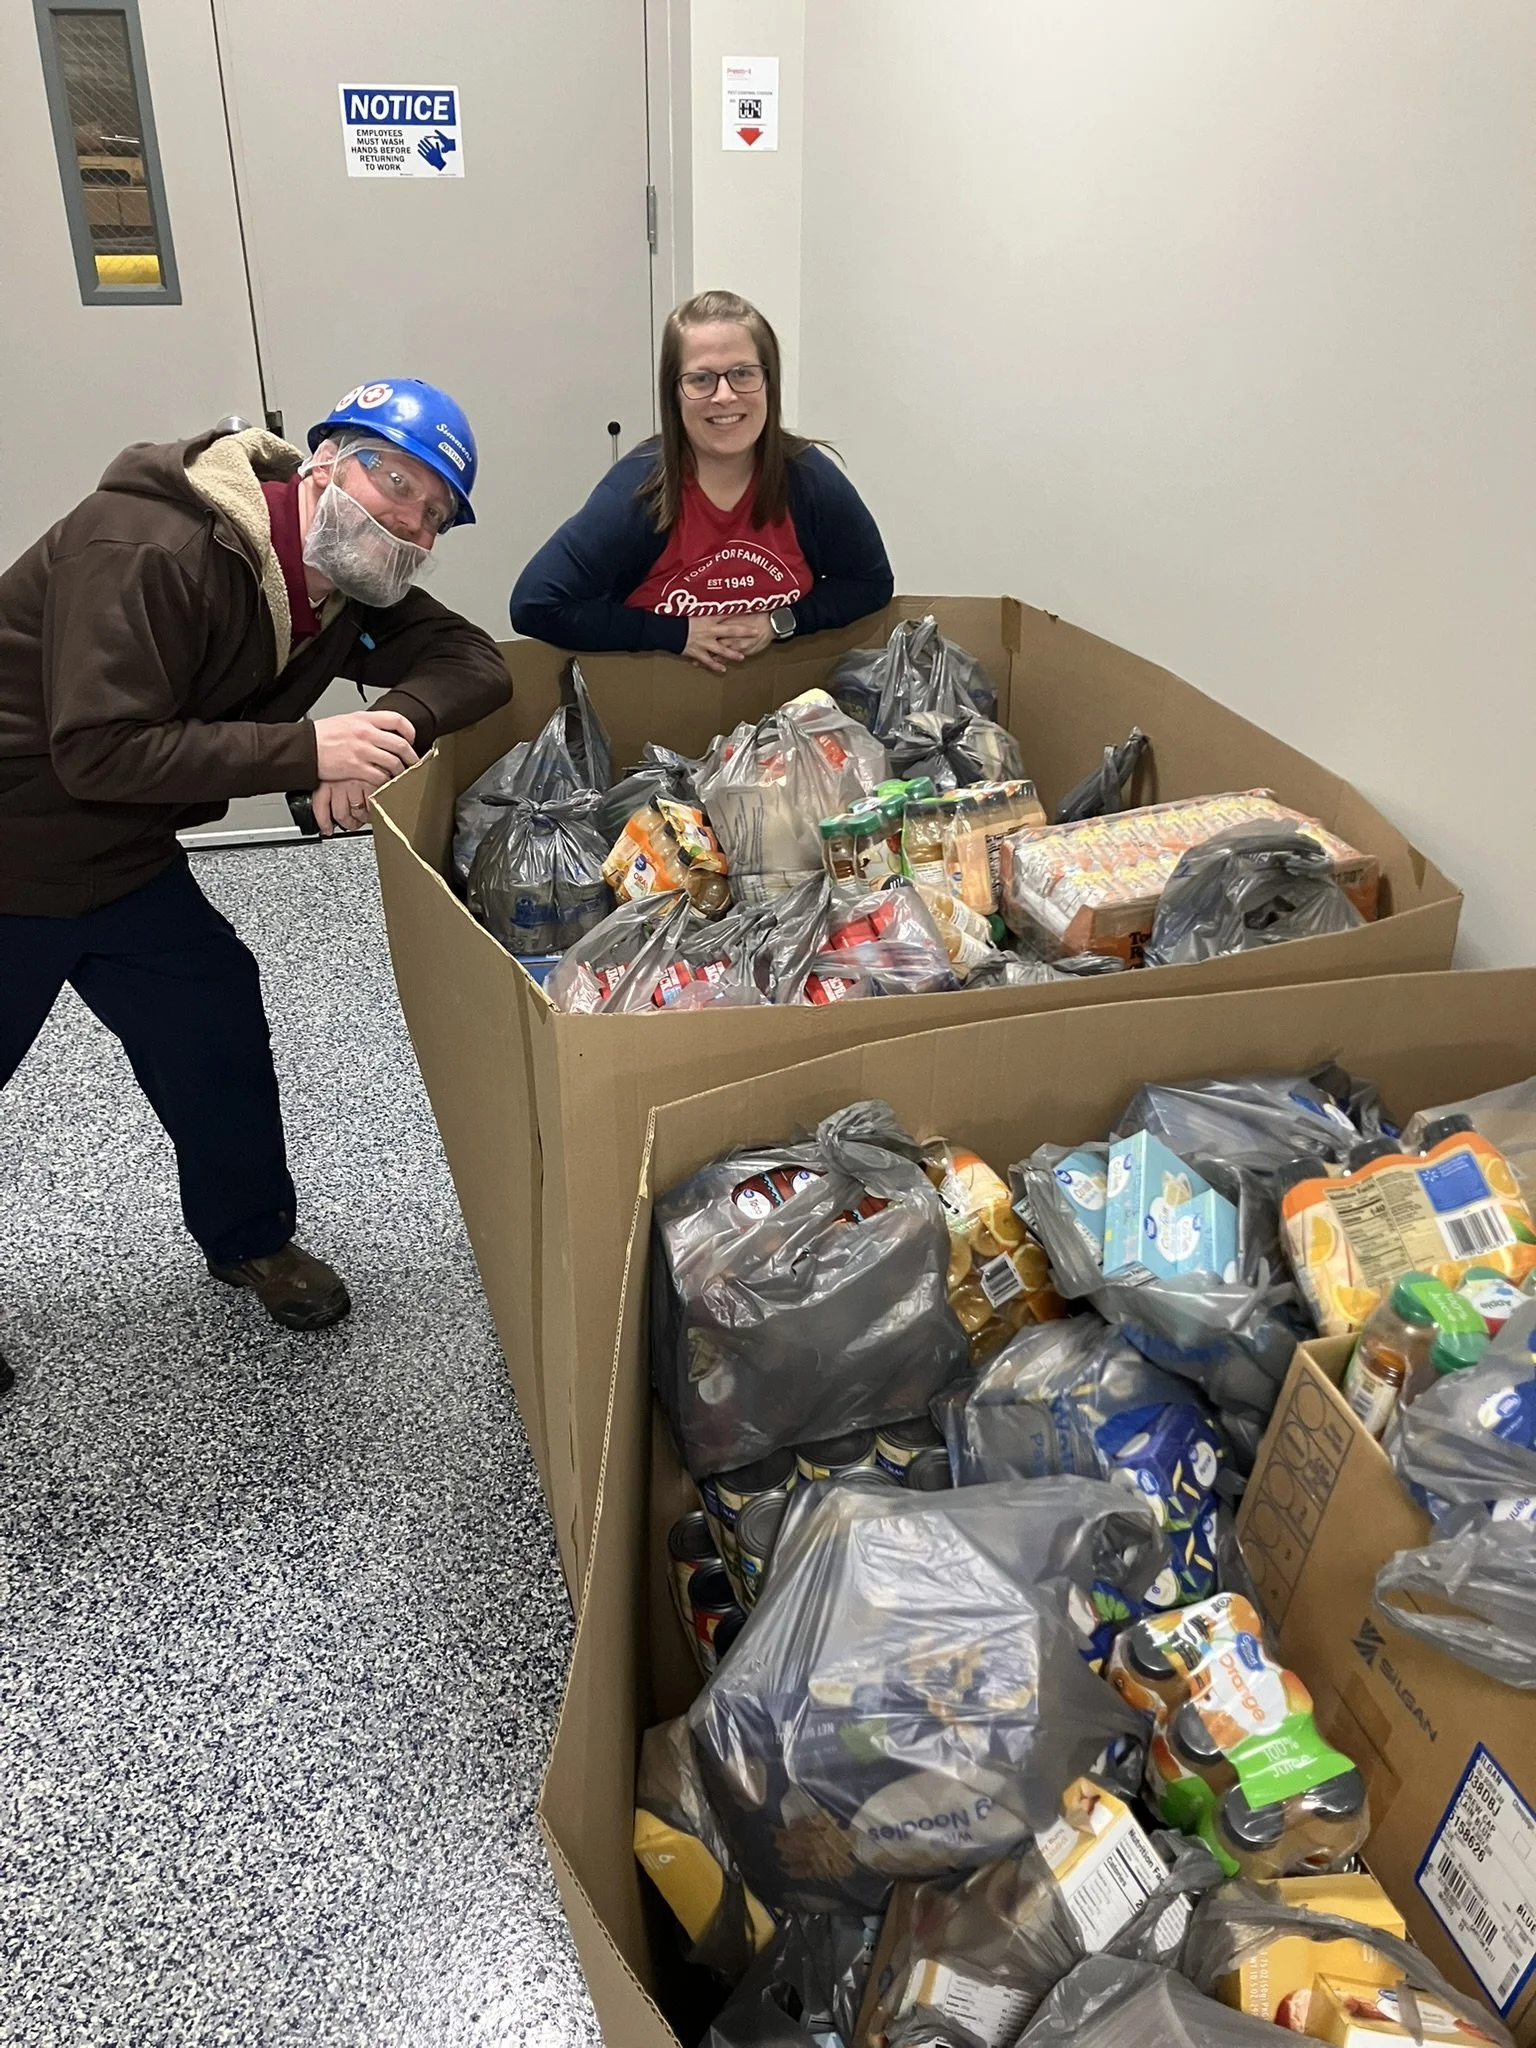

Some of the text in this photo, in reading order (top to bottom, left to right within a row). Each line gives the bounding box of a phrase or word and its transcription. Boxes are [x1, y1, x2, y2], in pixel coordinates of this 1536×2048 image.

[350, 94, 450, 120] NOTICE
[356, 129, 403, 137] EMPLOYEES
[351, 146, 411, 154] HANDS BEFORE
[360, 155, 405, 163] RETURNING
[365, 163, 401, 171] TO WORK
[436, 423, 473, 463] Simmons
[715, 549, 737, 562] FOR
[737, 549, 784, 582] FAMILIES
[707, 575, 754, 589] EST 1949
[1480, 1298, 1512, 1310] Apple
[1506, 1496, 1531, 1521] Penn
[1218, 1652, 1266, 1723] Orange
[1378, 1657, 1439, 1743] SILGAN
[867, 1808, 971, 1843] Noodles
[1458, 1795, 1474, 1819] LAIN
[1474, 1816, 1491, 1843] BLUE
[1462, 1787, 1482, 1816] CREW
[1481, 1813, 1496, 1834] CAP
[1105, 1856, 1129, 1887] Calories
[1127, 1829, 1166, 1884] Nutrition Fac
[1516, 1902, 1536, 1936] BLUE
